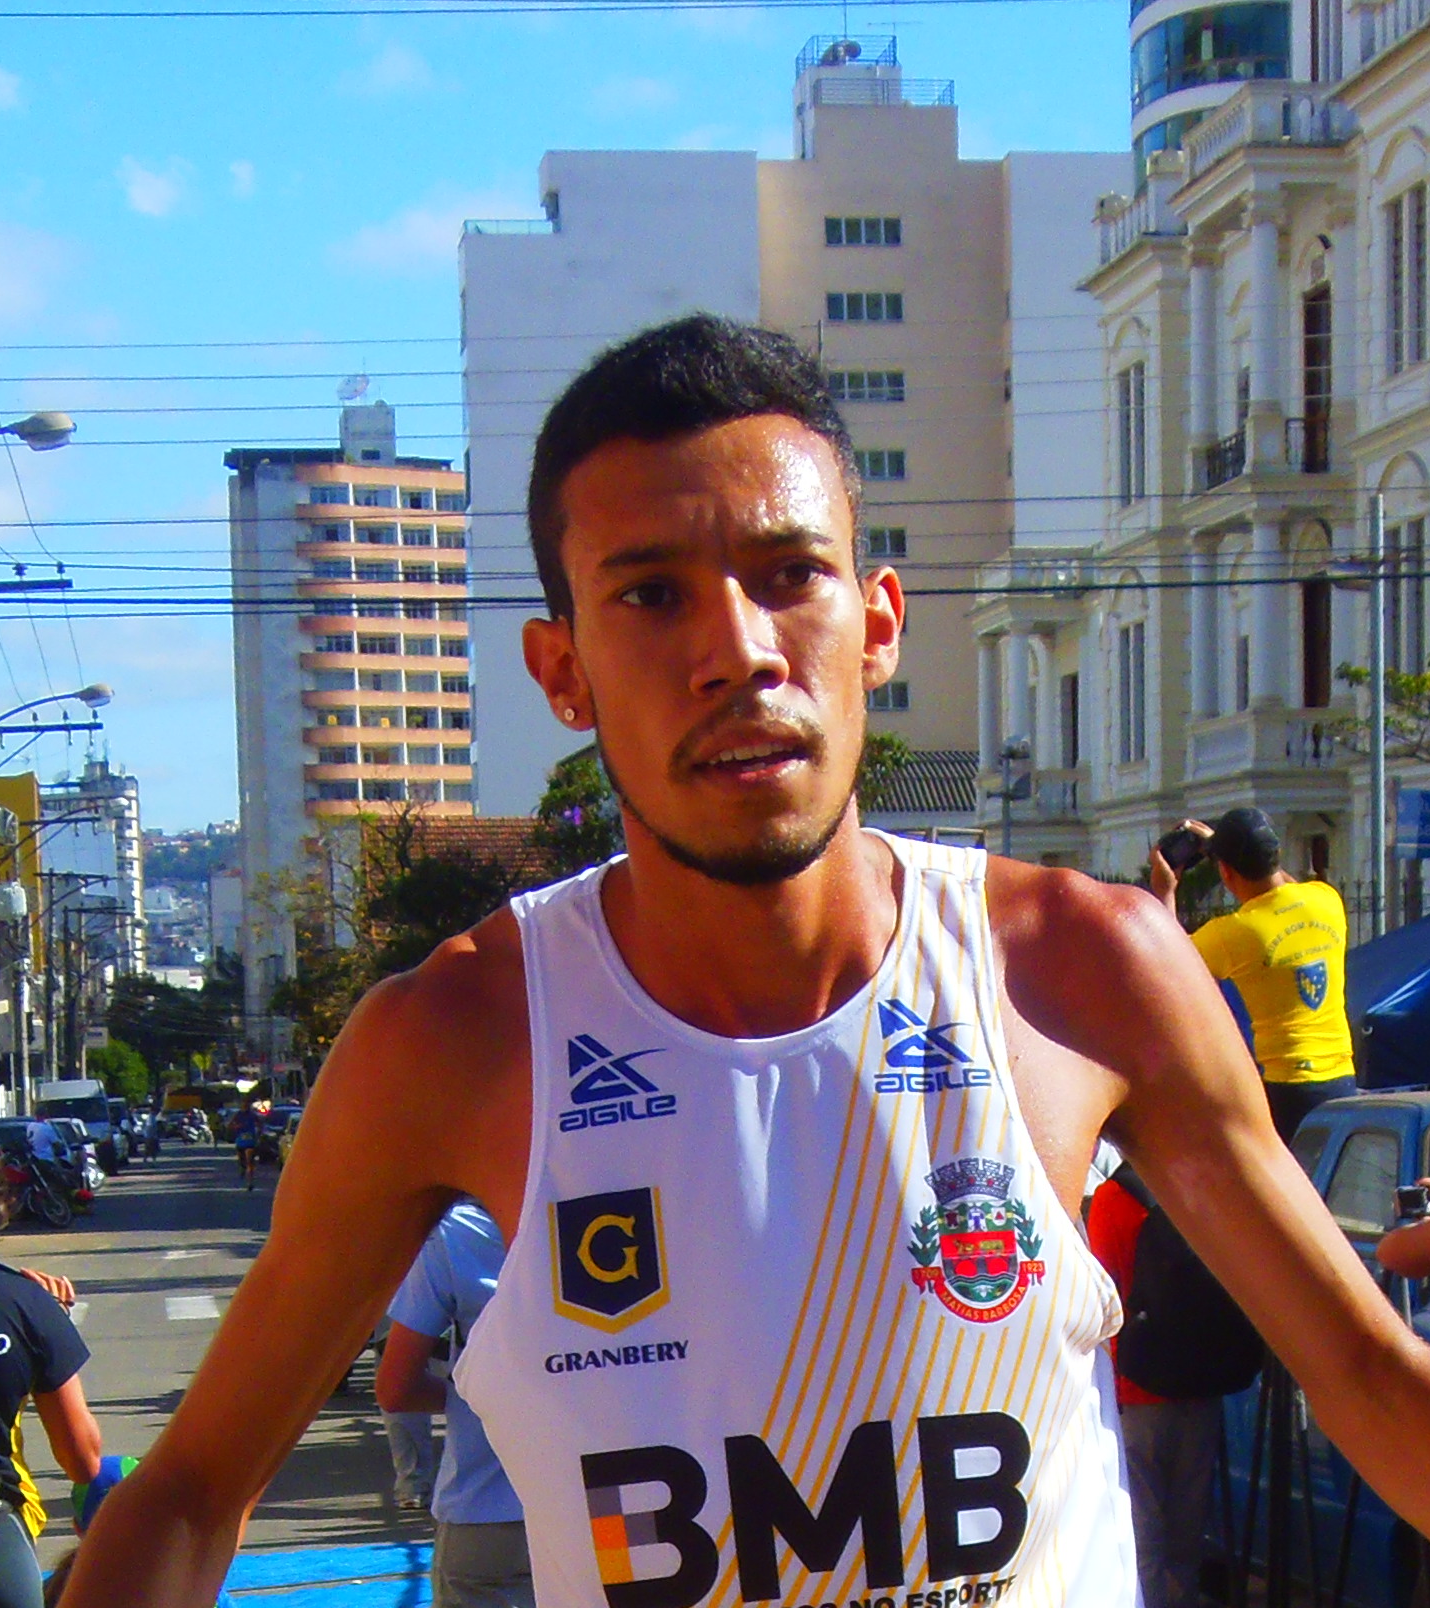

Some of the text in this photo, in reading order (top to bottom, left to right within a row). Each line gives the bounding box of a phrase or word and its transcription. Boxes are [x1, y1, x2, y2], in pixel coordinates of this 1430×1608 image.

[577, 1213, 640, 1283] G
[1023, 1262, 1043, 1273] 1923
[941, 1286, 1026, 1320] MATIAS BARBOSA
[545, 1340, 689, 1374] GRANBERY
